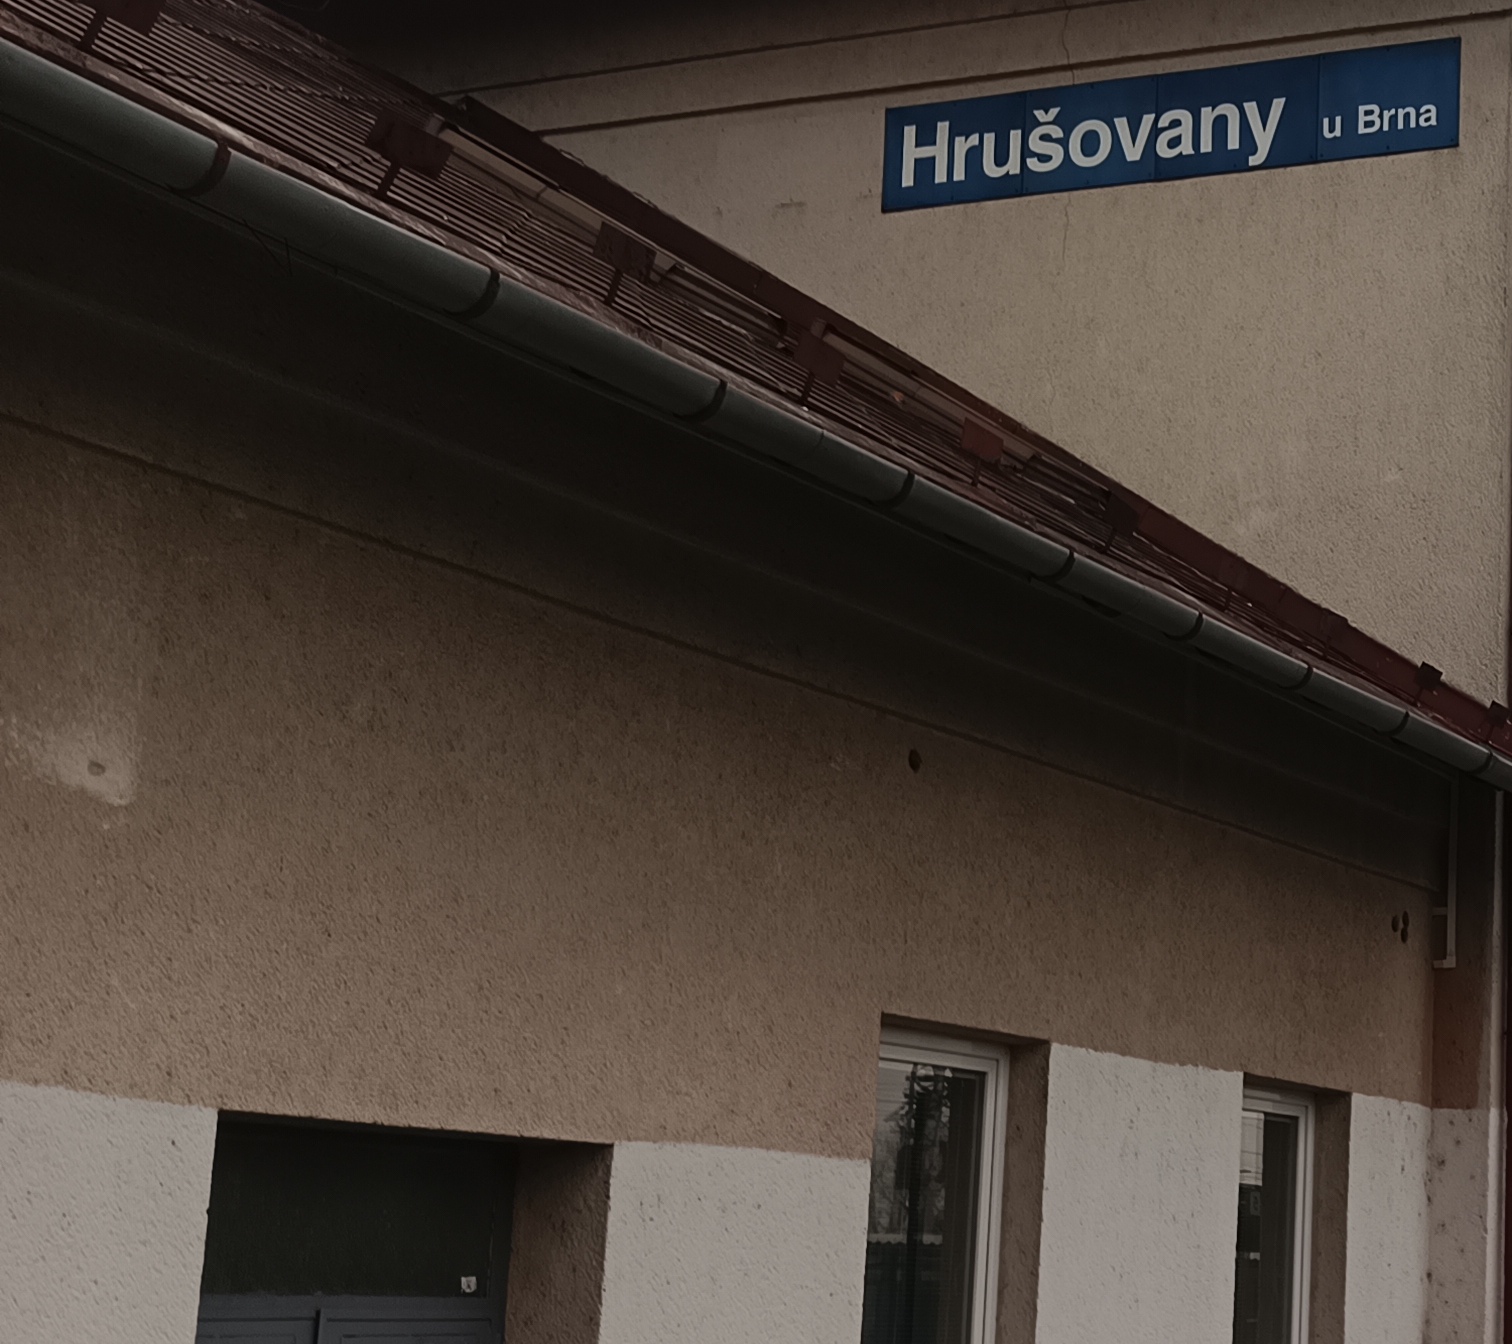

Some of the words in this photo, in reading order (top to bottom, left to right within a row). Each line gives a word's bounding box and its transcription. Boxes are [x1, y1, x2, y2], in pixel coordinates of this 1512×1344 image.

[901, 96, 1287, 188] Hrušovany
[1322, 115, 1343, 139] u
[1356, 102, 1439, 135] Brna
